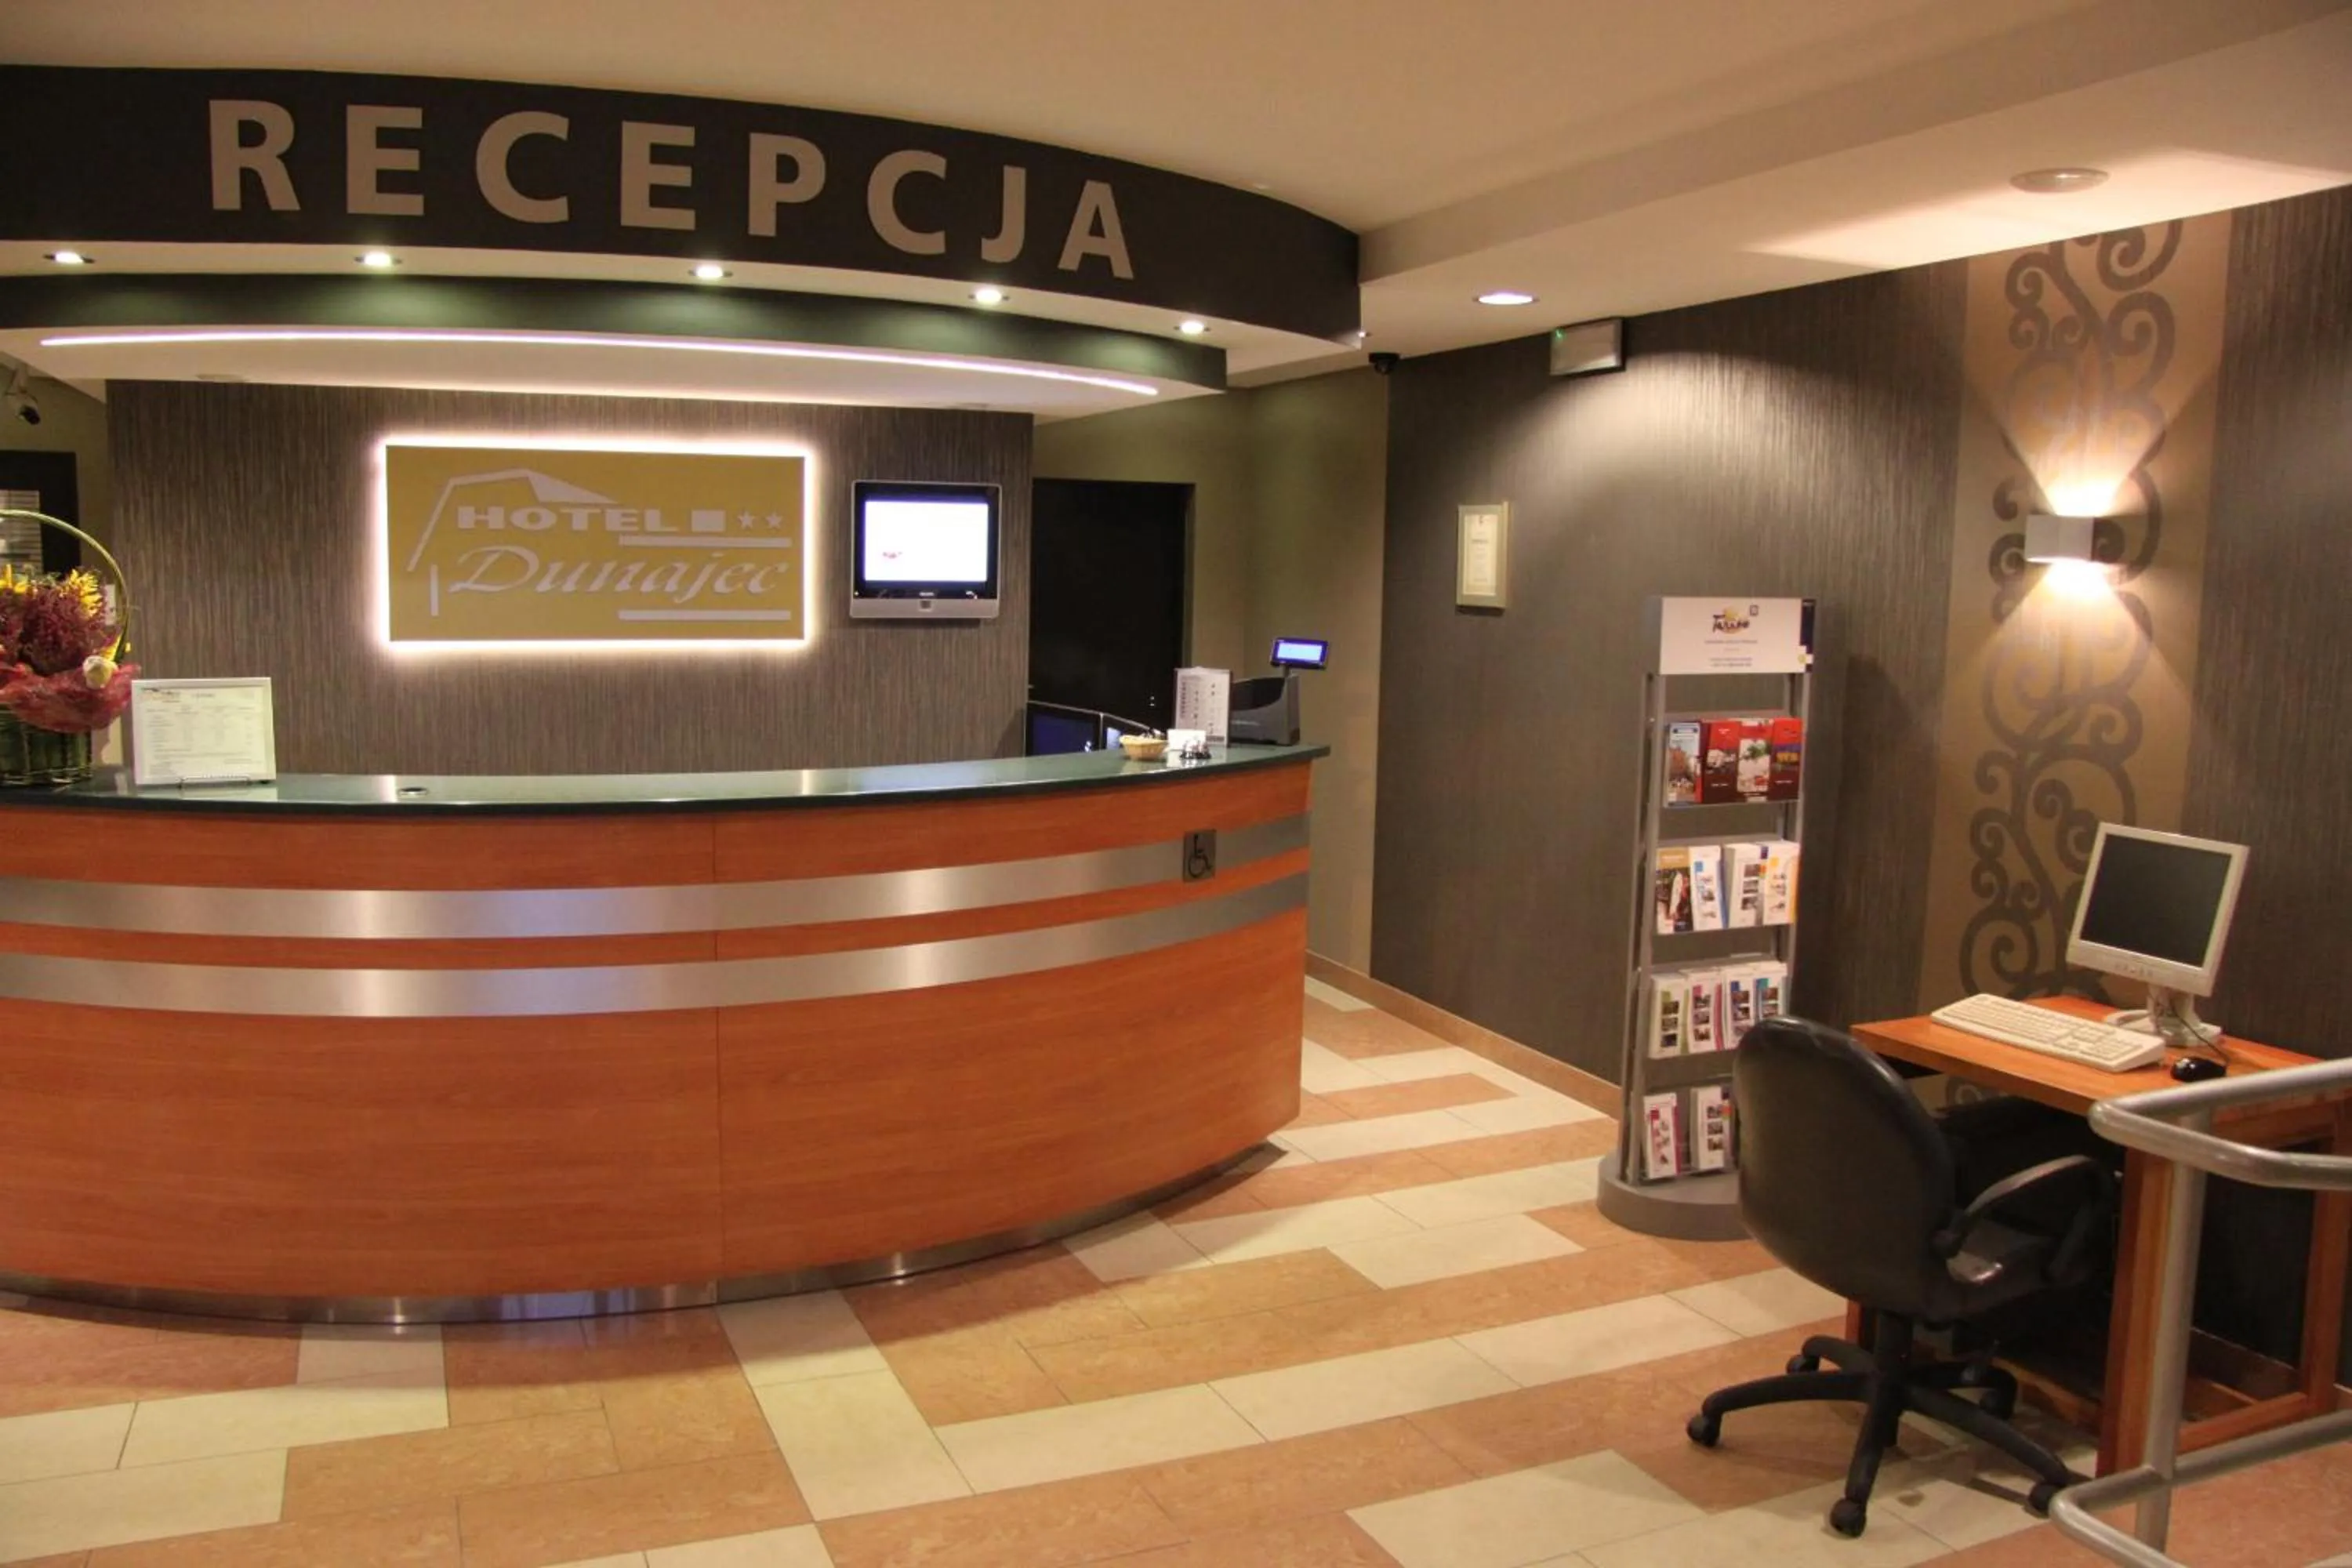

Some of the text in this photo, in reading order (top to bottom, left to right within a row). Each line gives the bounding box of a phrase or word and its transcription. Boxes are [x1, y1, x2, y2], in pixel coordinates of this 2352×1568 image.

[209, 99, 1134, 280] RECEPCJA
[457, 506, 680, 532] HOTEL
[448, 545, 789, 604] Dunajec
